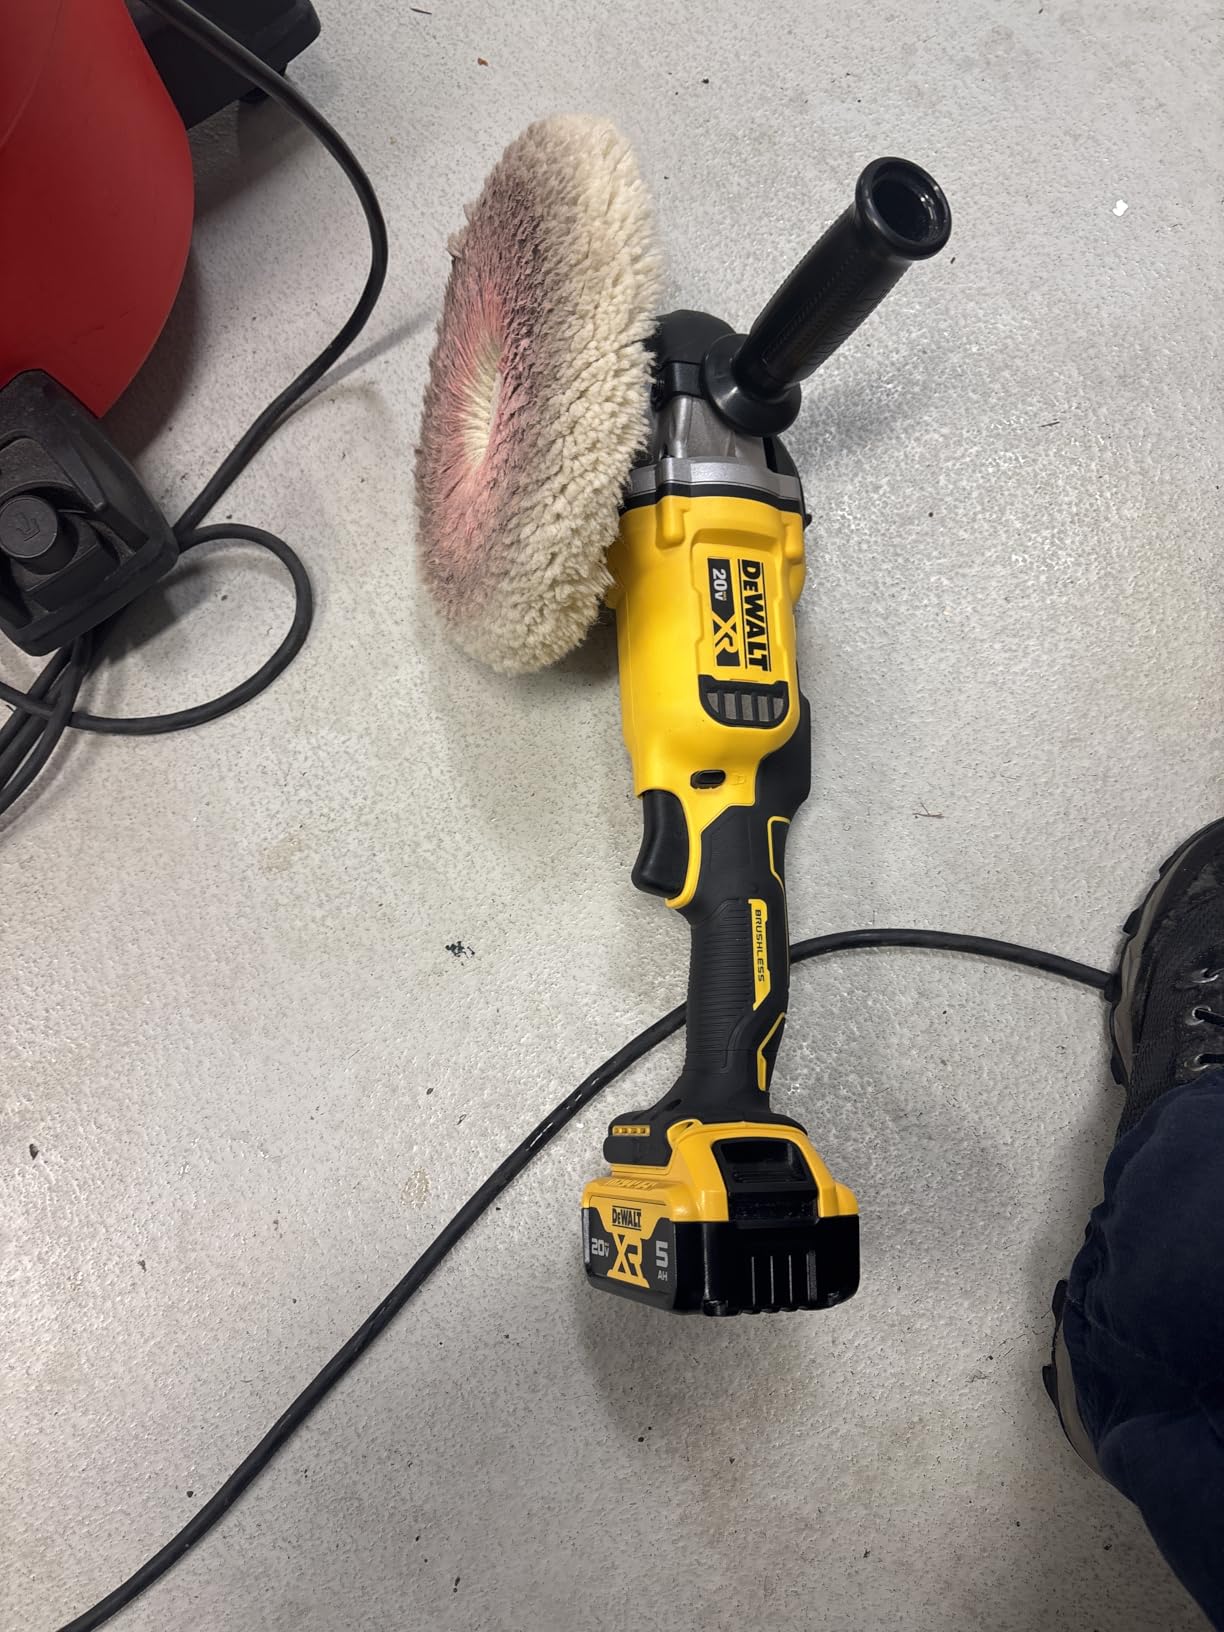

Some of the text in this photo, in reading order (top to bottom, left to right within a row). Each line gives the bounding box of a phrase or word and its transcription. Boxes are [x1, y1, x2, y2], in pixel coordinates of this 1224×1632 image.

[711, 610, 739, 658] XR
[741, 559, 768, 671] DEWALT
[755, 909, 765, 982] BRUSHLESS
[612, 1207, 641, 1228] DEWALT
[607, 1232, 650, 1289] XR
[655, 1240, 668, 1268] 5
[657, 1270, 668, 1281] AH
